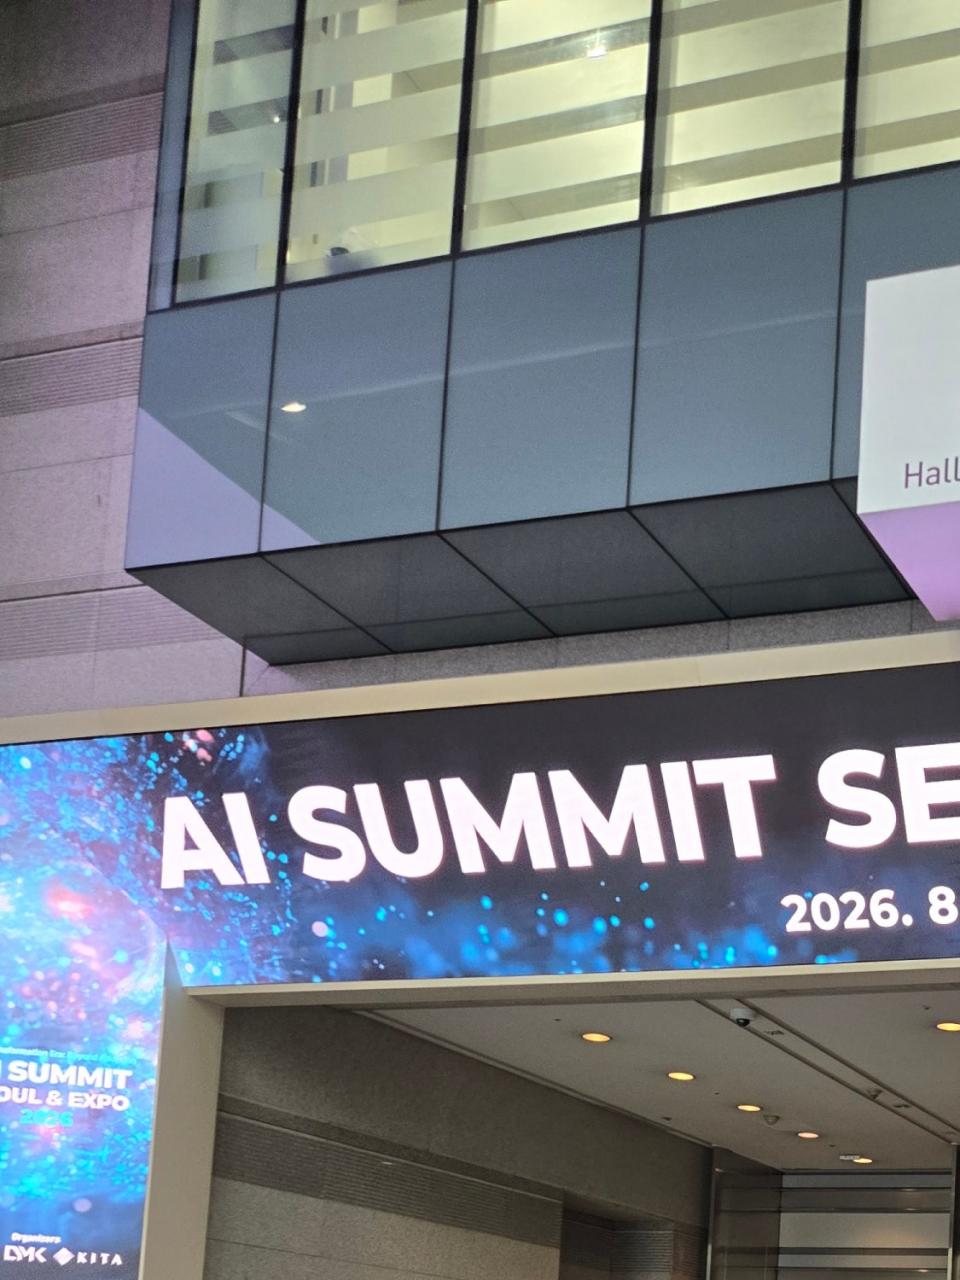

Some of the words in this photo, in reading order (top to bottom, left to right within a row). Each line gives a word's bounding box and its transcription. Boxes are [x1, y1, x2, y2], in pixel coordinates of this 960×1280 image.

[904, 457, 960, 488] Hall
[160, 792, 271, 889] AI
[287, 754, 776, 882] SUMMIT
[780, 889, 913, 932] 2026.
[7, 1059, 133, 1090] SUMMIT
[0, 1085, 43, 1105] OUL
[46, 1089, 62, 1106] &
[68, 1091, 130, 1112] EXPO
[20, 1107, 74, 1127] 2026
[76, 1251, 123, 1266] KITA
